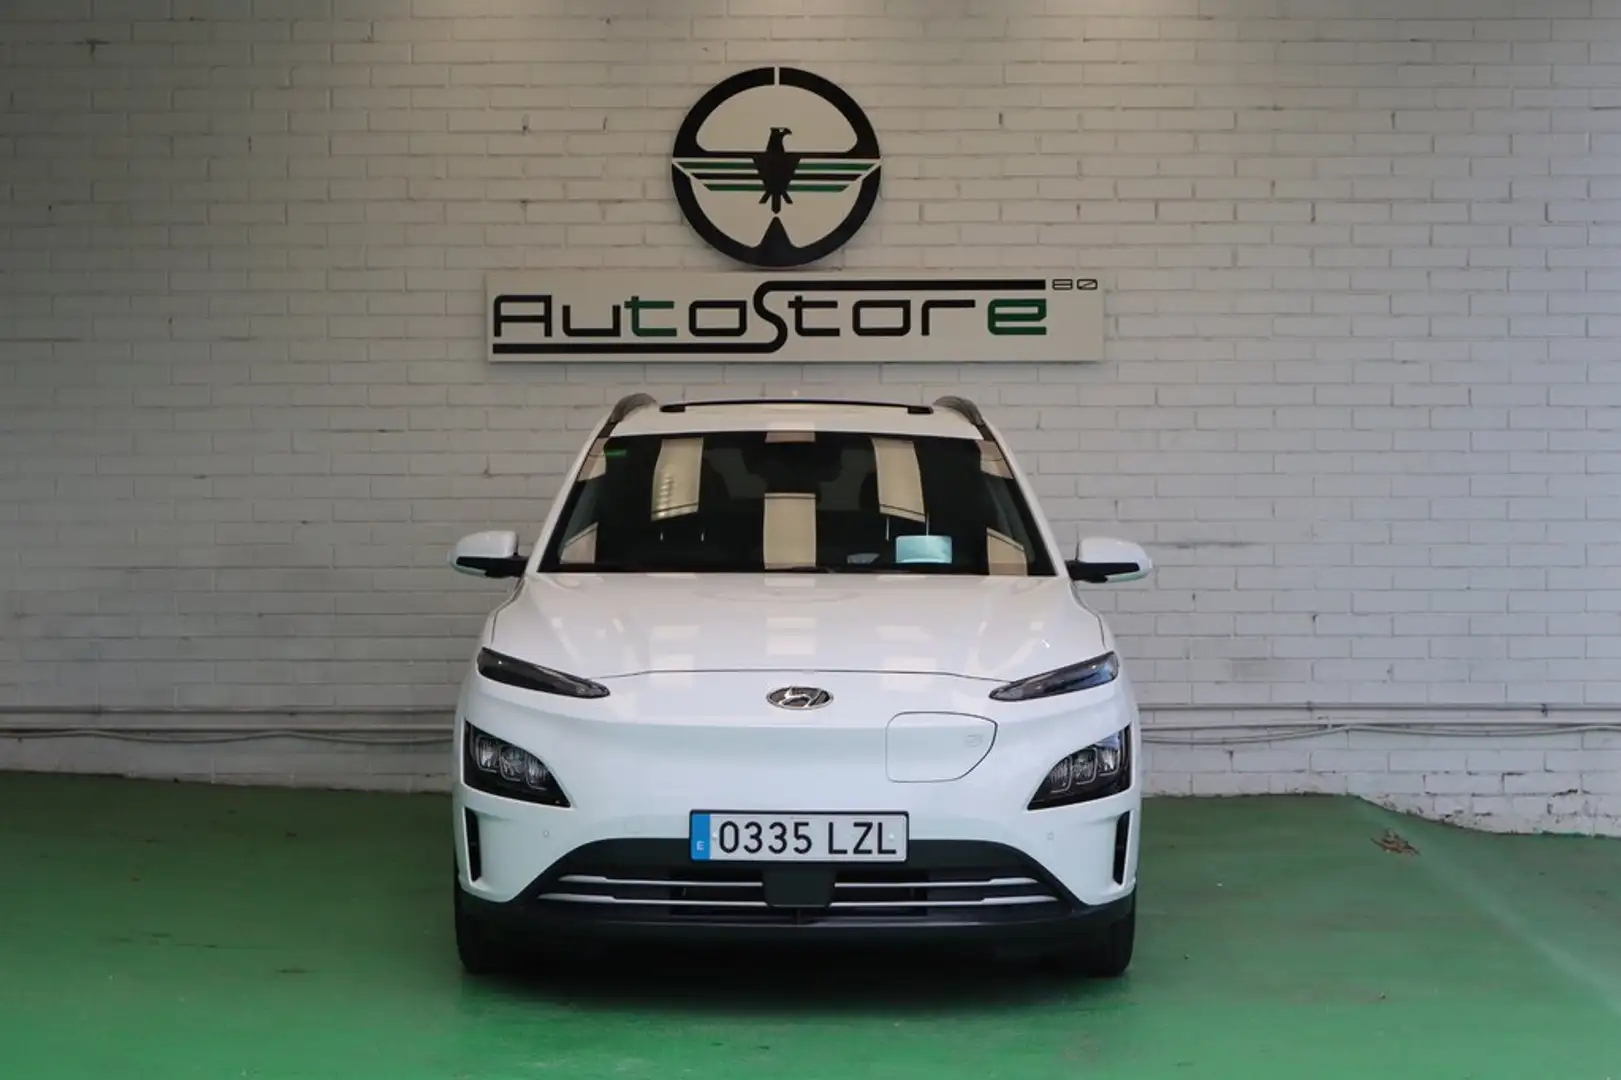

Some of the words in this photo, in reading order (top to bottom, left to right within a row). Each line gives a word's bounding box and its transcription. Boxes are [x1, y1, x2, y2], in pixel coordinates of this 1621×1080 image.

[493, 279, 1048, 354] AutoStore
[1052, 279, 1098, 291] 80
[696, 840, 705, 851] E
[718, 820, 813, 855] 0335
[828, 821, 898, 855] LZL
